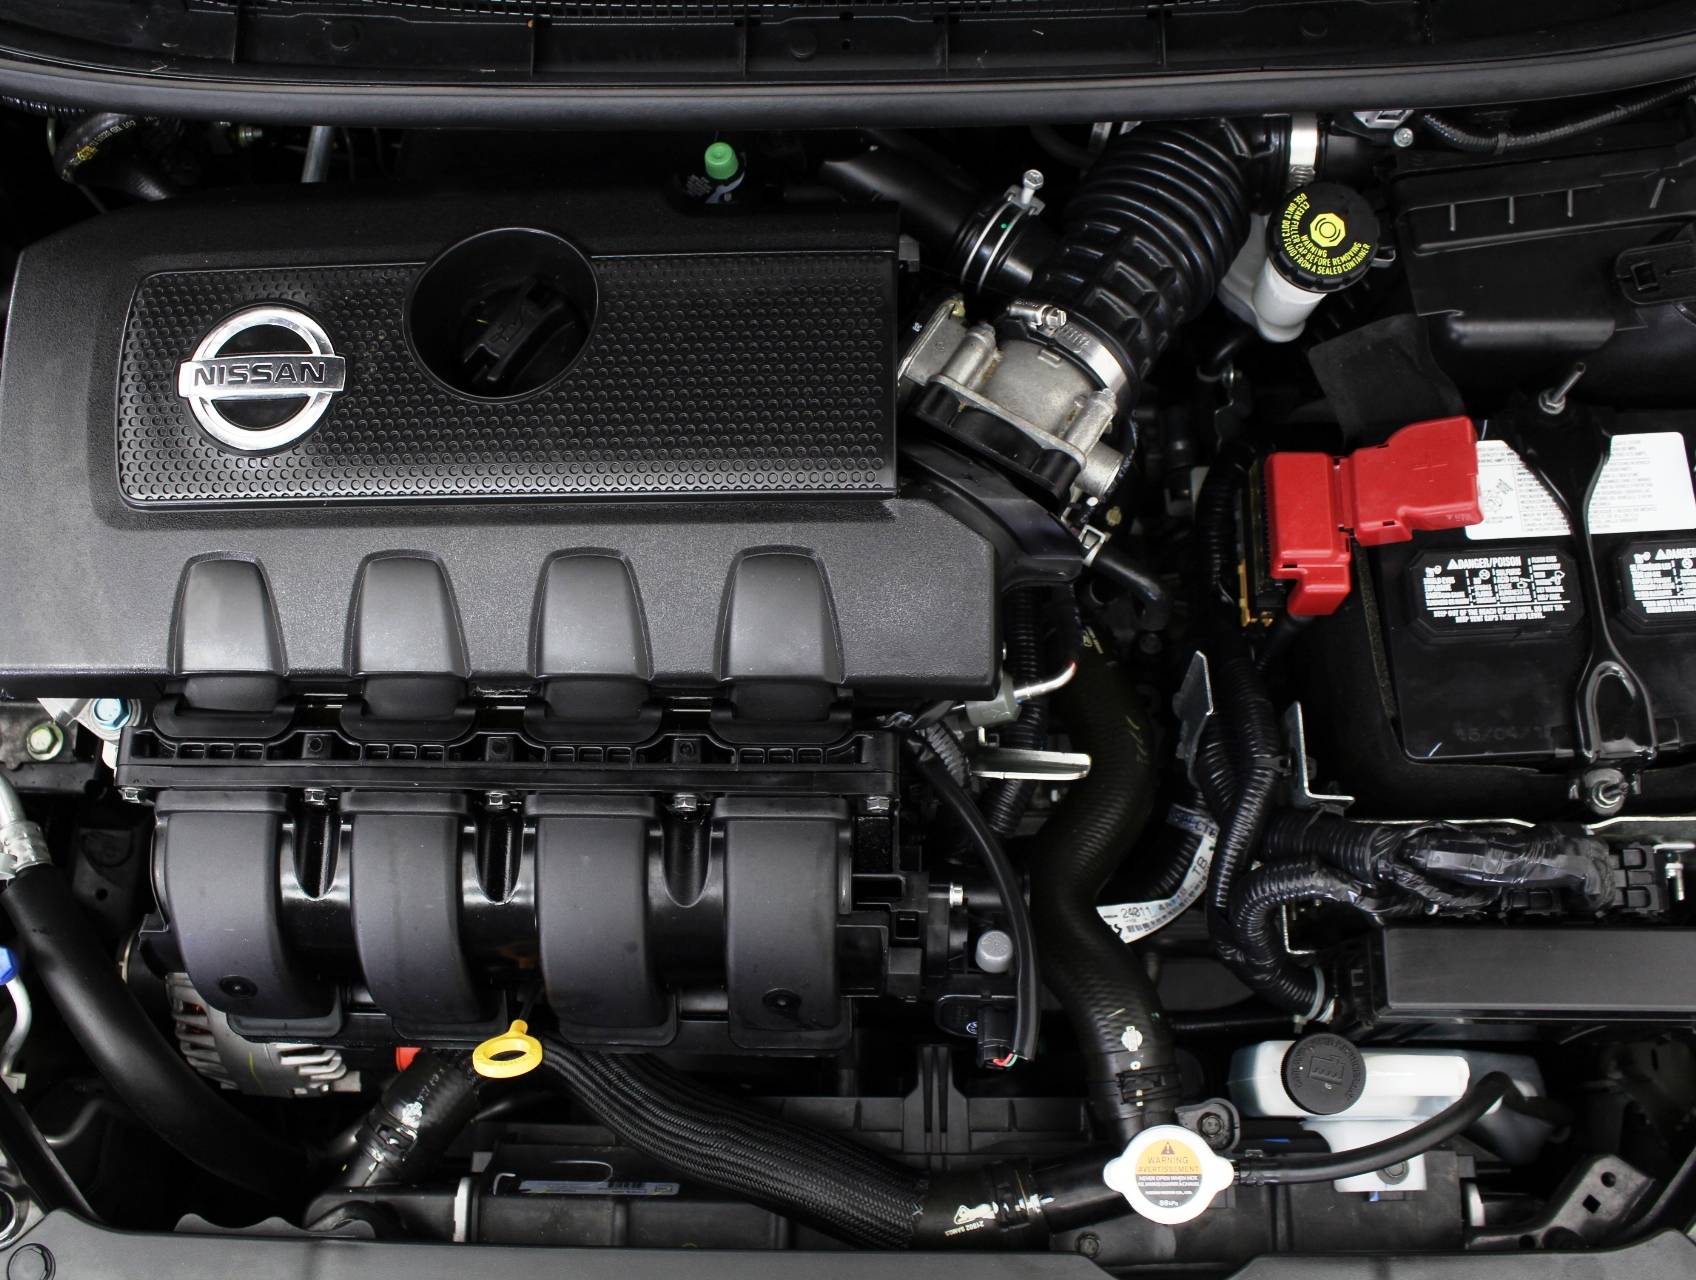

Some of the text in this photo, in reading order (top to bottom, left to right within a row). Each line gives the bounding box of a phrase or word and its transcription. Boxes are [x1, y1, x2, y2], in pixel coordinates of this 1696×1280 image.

[1294, 193, 1308, 204] USE
[1284, 203, 1298, 219] ONLY
[1282, 220, 1290, 237] DOT3
[1290, 201, 1361, 266] CLEAN FILLER CAP BEFORE REMOVING
[1283, 238, 1298, 257] FLUID
[1300, 234, 1327, 258] WARNING
[1293, 254, 1312, 270] FROM
[1342, 243, 1371, 272] CONTAINER
[1317, 266, 1343, 275] SEALED
[194, 361, 326, 386] NISSAN
[1457, 556, 1522, 569] DANGER/POISON
